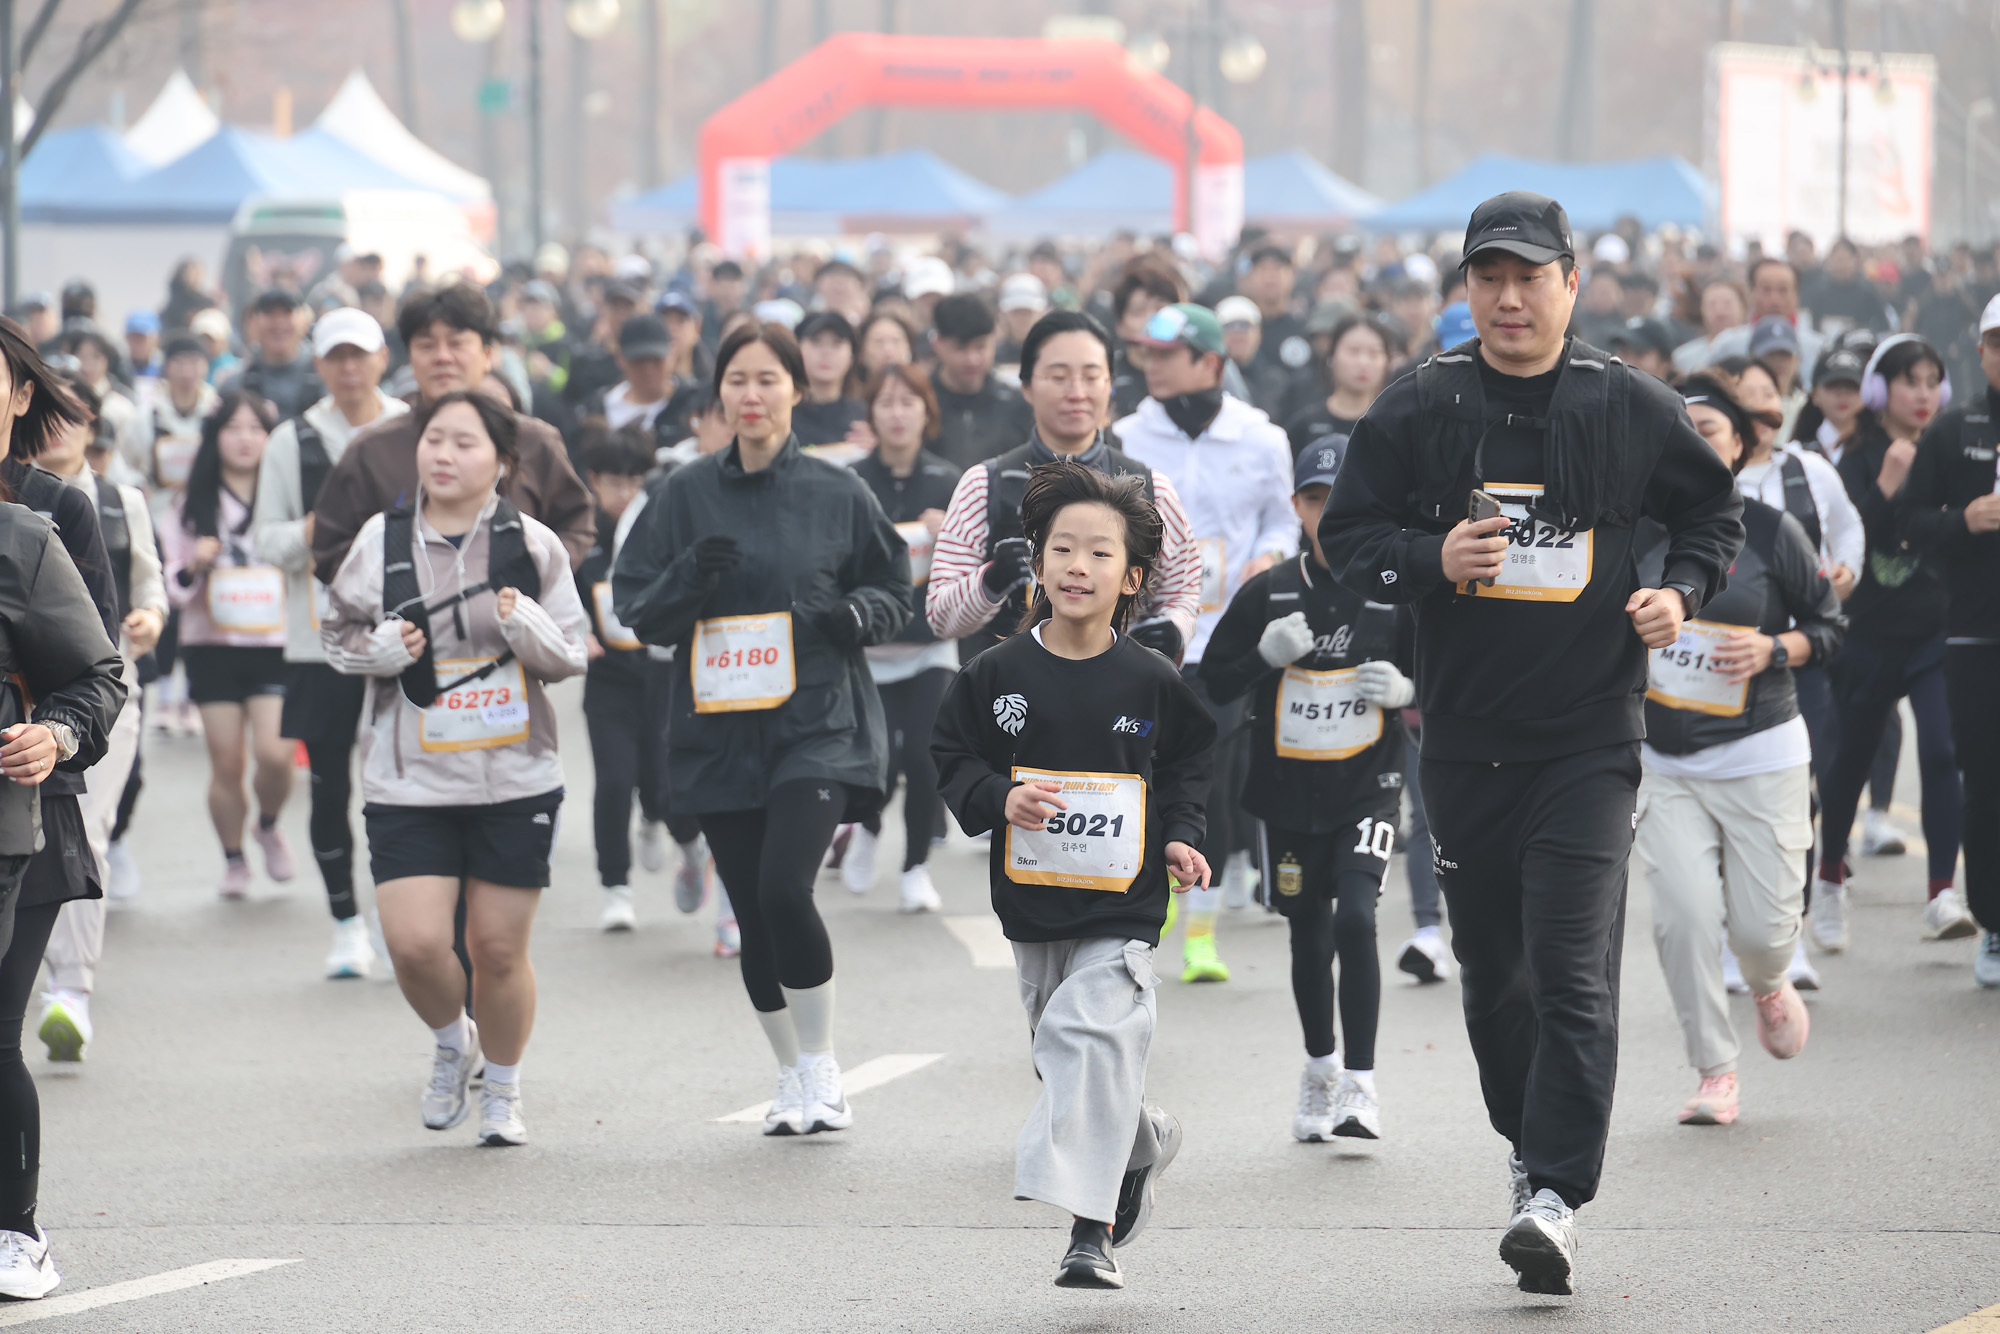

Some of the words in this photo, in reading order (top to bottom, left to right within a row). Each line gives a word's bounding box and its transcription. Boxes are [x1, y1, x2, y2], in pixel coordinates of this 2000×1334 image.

[1290, 700, 1366, 720] M5176
[1062, 781, 1086, 791] RUN
[1086, 782, 1120, 792] STORY
[1040, 812, 1124, 837] 5021
[1353, 817, 1395, 861] 10
[1016, 856, 1038, 867] 5km
